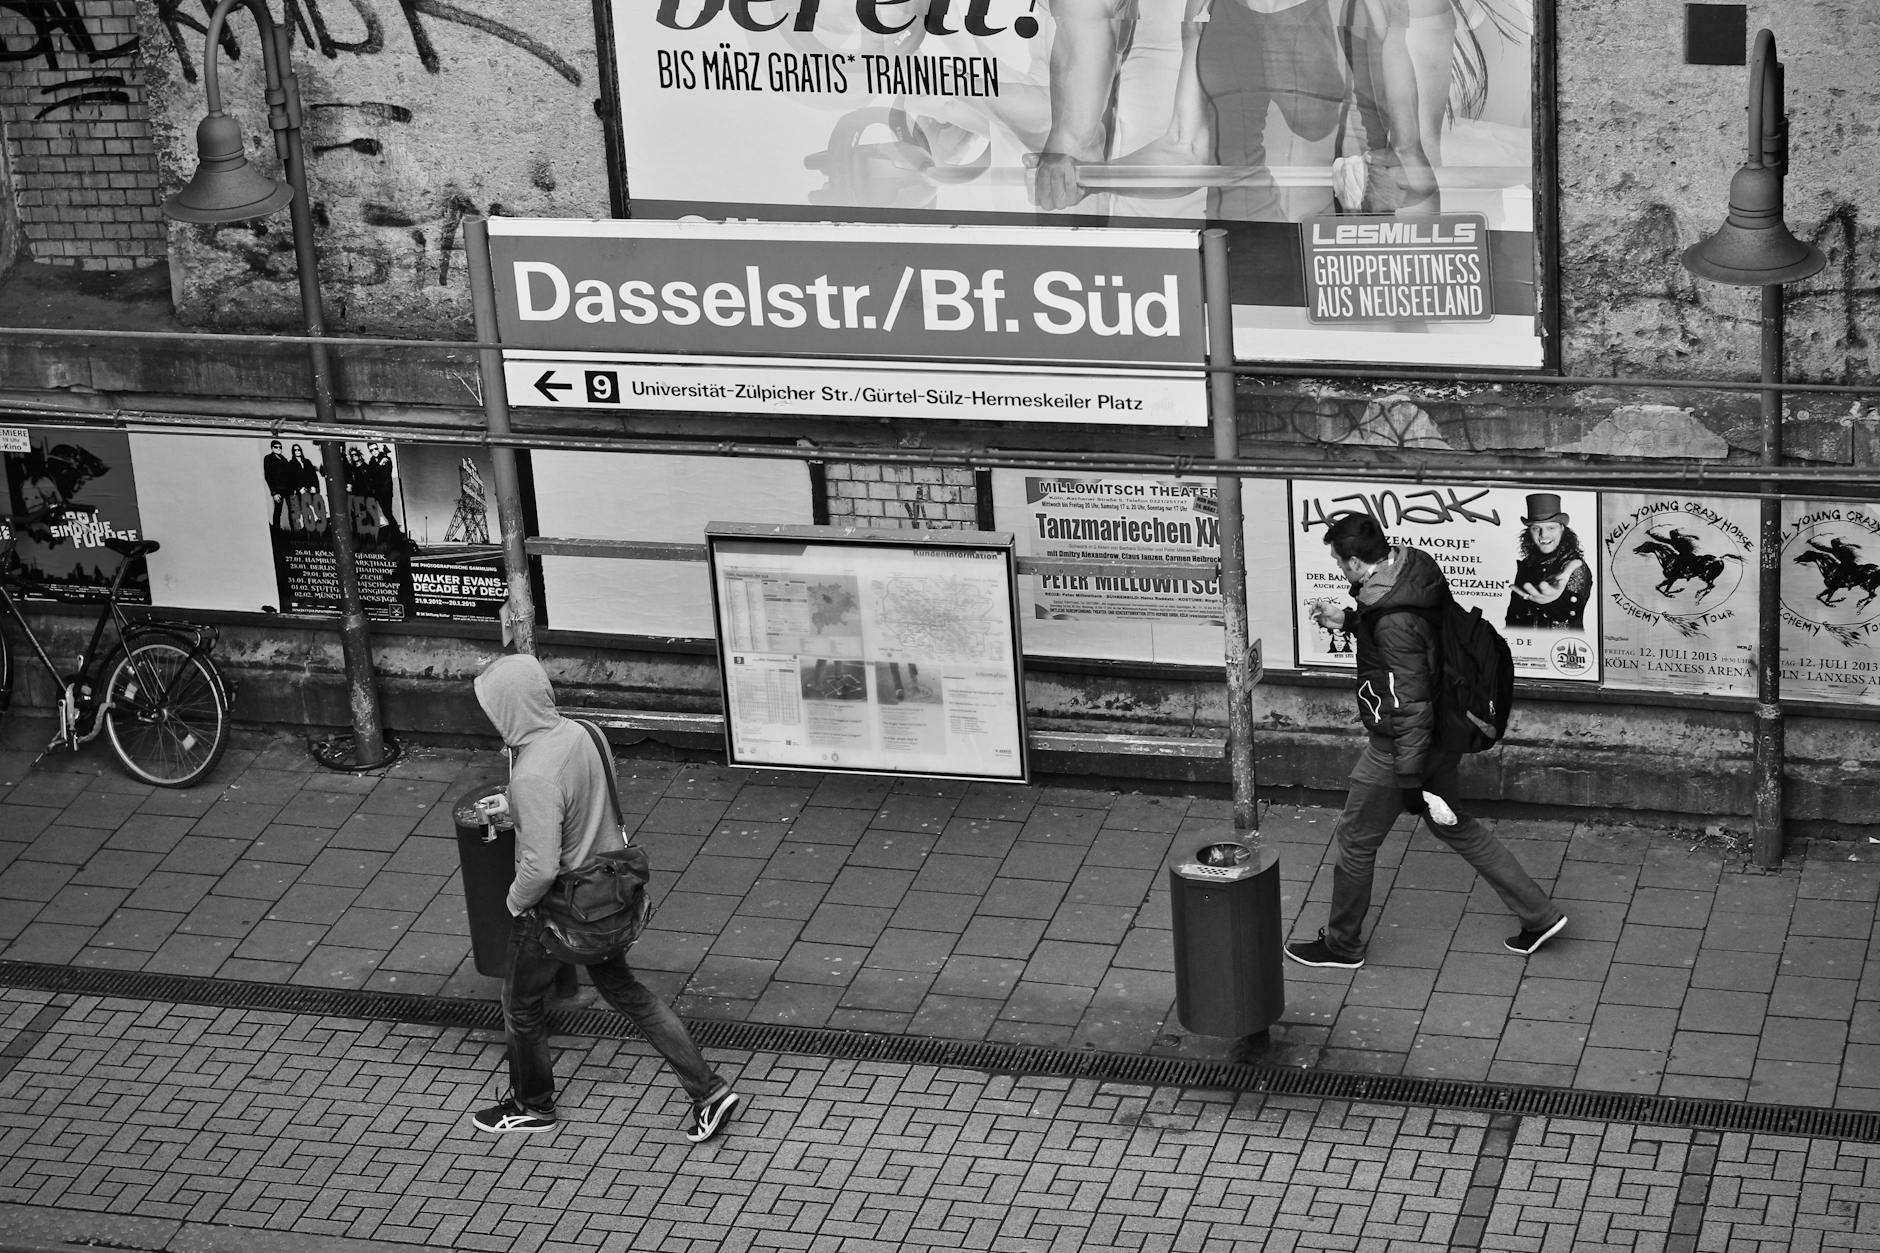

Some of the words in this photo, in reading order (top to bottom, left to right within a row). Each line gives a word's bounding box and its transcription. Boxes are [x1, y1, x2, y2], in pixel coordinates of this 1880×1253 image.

[656, 50, 696, 90] BIS
[702, 43, 763, 92] MÄRZ
[861, 54, 999, 98] TRAINIEREN
[1313, 253, 1481, 286] GRUPPENFITNESS
[1032, 269, 1181, 338] Süd
[1317, 286, 1354, 318] AUS
[1359, 285, 1483, 317] NEUSEELAND
[592, 374, 612, 399] 9
[632, 380, 815, 404] Universität-Zülpicher
[821, 386, 1092, 410] Str./Gürtel-Sülz-Hermeskeiler
[1098, 394, 1143, 411] Platz
[1039, 482, 1145, 496] MILLOWITSCH
[1149, 486, 1218, 498] THEATER
[1035, 513, 1192, 544] Tanzmariechen
[1195, 516, 1221, 548] XX
[1605, 521, 1631, 557] NEIL
[1630, 500, 1680, 527] YOUNG
[1684, 502, 1724, 526] CRAZY
[1720, 519, 1755, 553] HORSE
[1791, 508, 1842, 537] YOUNG
[1059, 550, 1080, 559] Dmitry
[1165, 554, 1191, 562] Carmen
[1434, 553, 1483, 564] HANDEL
[411, 573, 460, 584] WALKER
[1306, 573, 1326, 581] DER
[1328, 573, 1349, 582] BAN
[1442, 565, 1477, 576] LBUM
[413, 583, 459, 594] DECADE
[462, 586, 478, 595] BY
[480, 586, 509, 597] DECA
[1095, 575, 1222, 595] MILLOWITSC
[1450, 590, 1503, 598] OADPORTALEN
[359, 595, 398, 603] ACKSTAGE
[1610, 592, 1661, 628] ALCHEMY
[1698, 609, 1736, 627] TOUR
[1779, 607, 1821, 637] LCHEMY
[1857, 622, 1880, 637] TO
[1639, 647, 1656, 657] 12.
[1659, 649, 1688, 660] JULI
[1691, 651, 1718, 662] 2013
[1604, 657, 1639, 669] KÖLN
[1647, 661, 1705, 675] LANXESS
[1707, 665, 1753, 678] ARENA
[1800, 657, 1816, 668] 12.
[1819, 658, 1848, 670] JULI
[1851, 661, 1878, 671] 2013
[1779, 669, 1799, 680] LN
[1807, 671, 1865, 685] LANXESS
